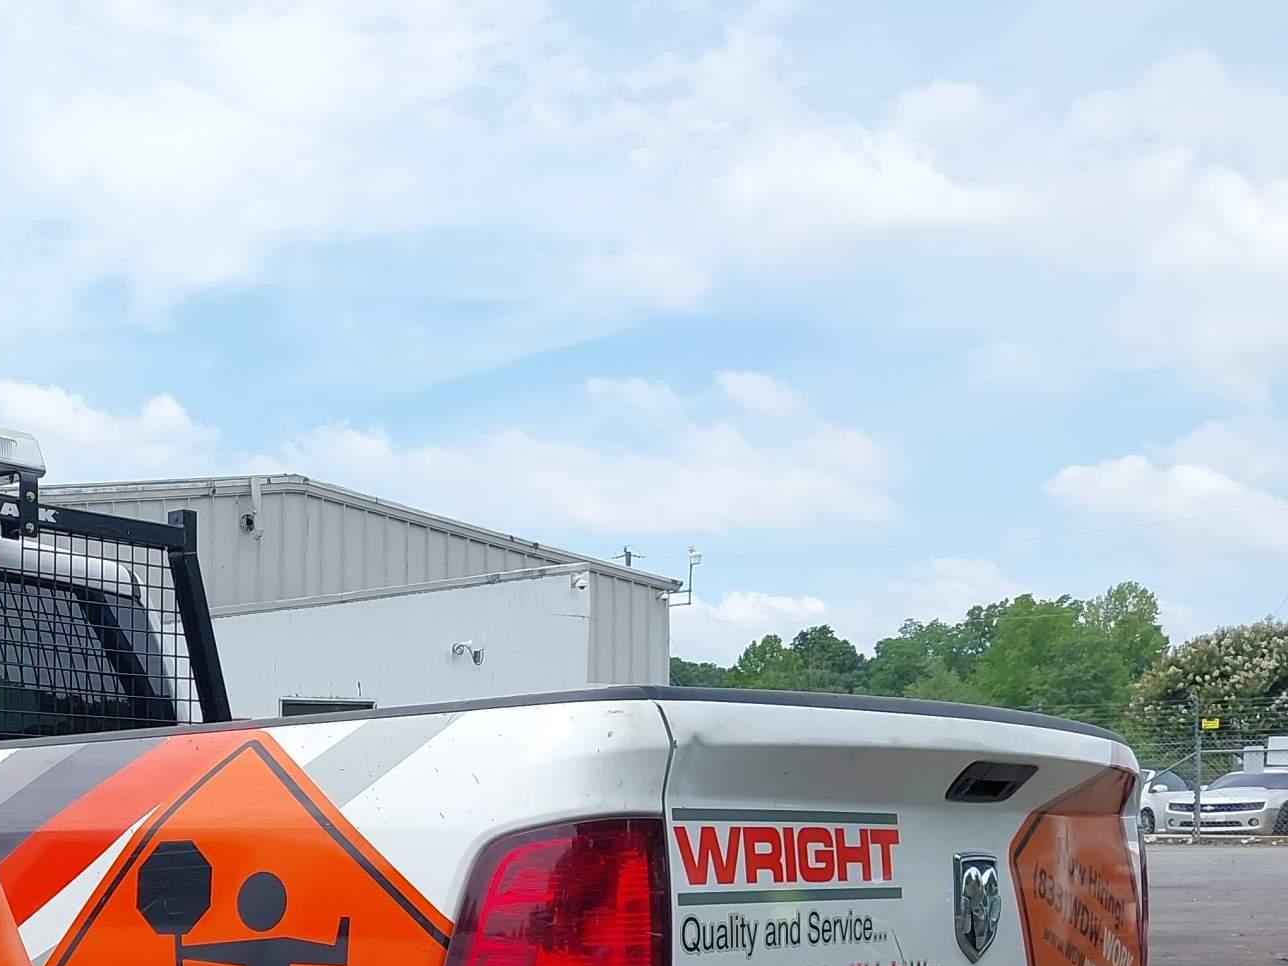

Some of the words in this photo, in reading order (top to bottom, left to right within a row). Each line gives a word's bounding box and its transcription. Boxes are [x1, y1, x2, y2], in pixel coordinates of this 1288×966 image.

[673, 826, 900, 885] WRIGHT
[681, 914, 758, 957] Quality
[765, 912, 801, 948] and
[807, 909, 888, 944] Service...
